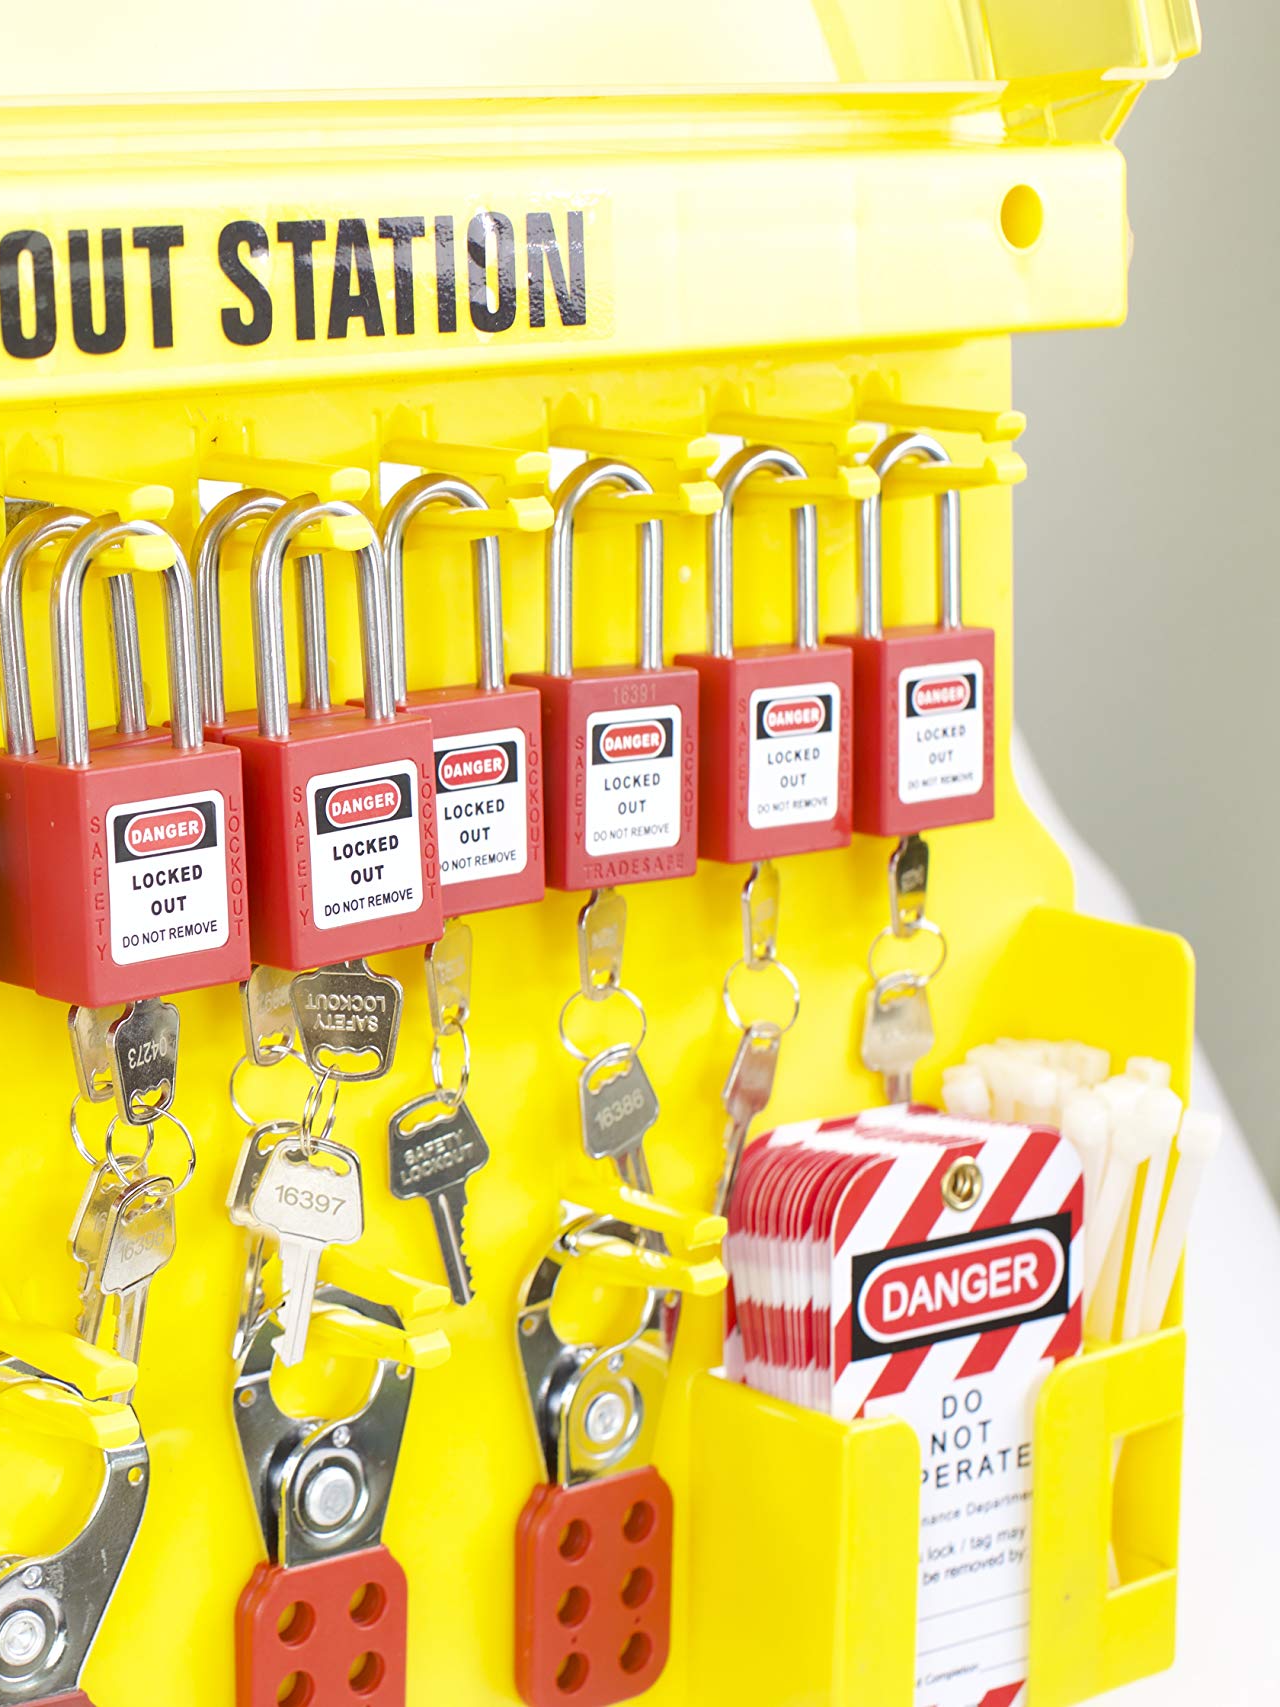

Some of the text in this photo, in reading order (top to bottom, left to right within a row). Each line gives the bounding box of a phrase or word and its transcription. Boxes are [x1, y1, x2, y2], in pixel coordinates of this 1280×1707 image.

[217, 210, 587, 346] STATION
[918, 685, 965, 706] DANGER
[768, 708, 820, 727] DANGER
[605, 733, 659, 751] DANGER
[917, 725, 966, 742] LOCKED
[444, 757, 502, 779] DANGER
[768, 748, 820, 765] LOCKED
[929, 750, 952, 764] OUT
[575, 737, 584, 845] SAFETY
[605, 773, 660, 791] LOCKED
[685, 726, 694, 832] LOCKOUT
[780, 774, 806, 788] OUT
[332, 792, 395, 816] DANGER
[528, 733, 540, 860] LOCKOUT
[618, 800, 646, 814] OUT
[758, 796, 828, 814] DO NOT REMOVE
[444, 799, 505, 820] LOCKED
[132, 820, 199, 845] DANGER
[421, 764, 436, 899] LOCKOUT
[460, 827, 490, 844] OUT
[594, 823, 669, 842] DO NOT REMOVE
[293, 786, 309, 925] SAFETY
[333, 835, 399, 861] LOCKED
[228, 796, 243, 936] LOCKOUT
[440, 850, 517, 872] O NOT REMOVE
[583, 853, 684, 879] TRADESAFE
[132, 865, 202, 890] LOCKED
[351, 865, 384, 885] OUT
[91, 816, 106, 960] SAFETY
[151, 896, 186, 915] OUT
[325, 888, 413, 916] DO NOT REMOVE
[123, 920, 218, 948] DO NOT REMOVE
[305, 994, 386, 1011] LOCKOUT
[313, 1014, 379, 1032] SAFETY
[128, 1036, 167, 1068] 04273
[404, 1129, 463, 1165] SAFETY
[400, 1143, 474, 1185] LOCKOUT
[275, 1185, 346, 1216] 16397
[882, 1252, 1038, 1322] DANGER
[942, 1389, 983, 1420] DO
[930, 1420, 992, 1456] NOT
